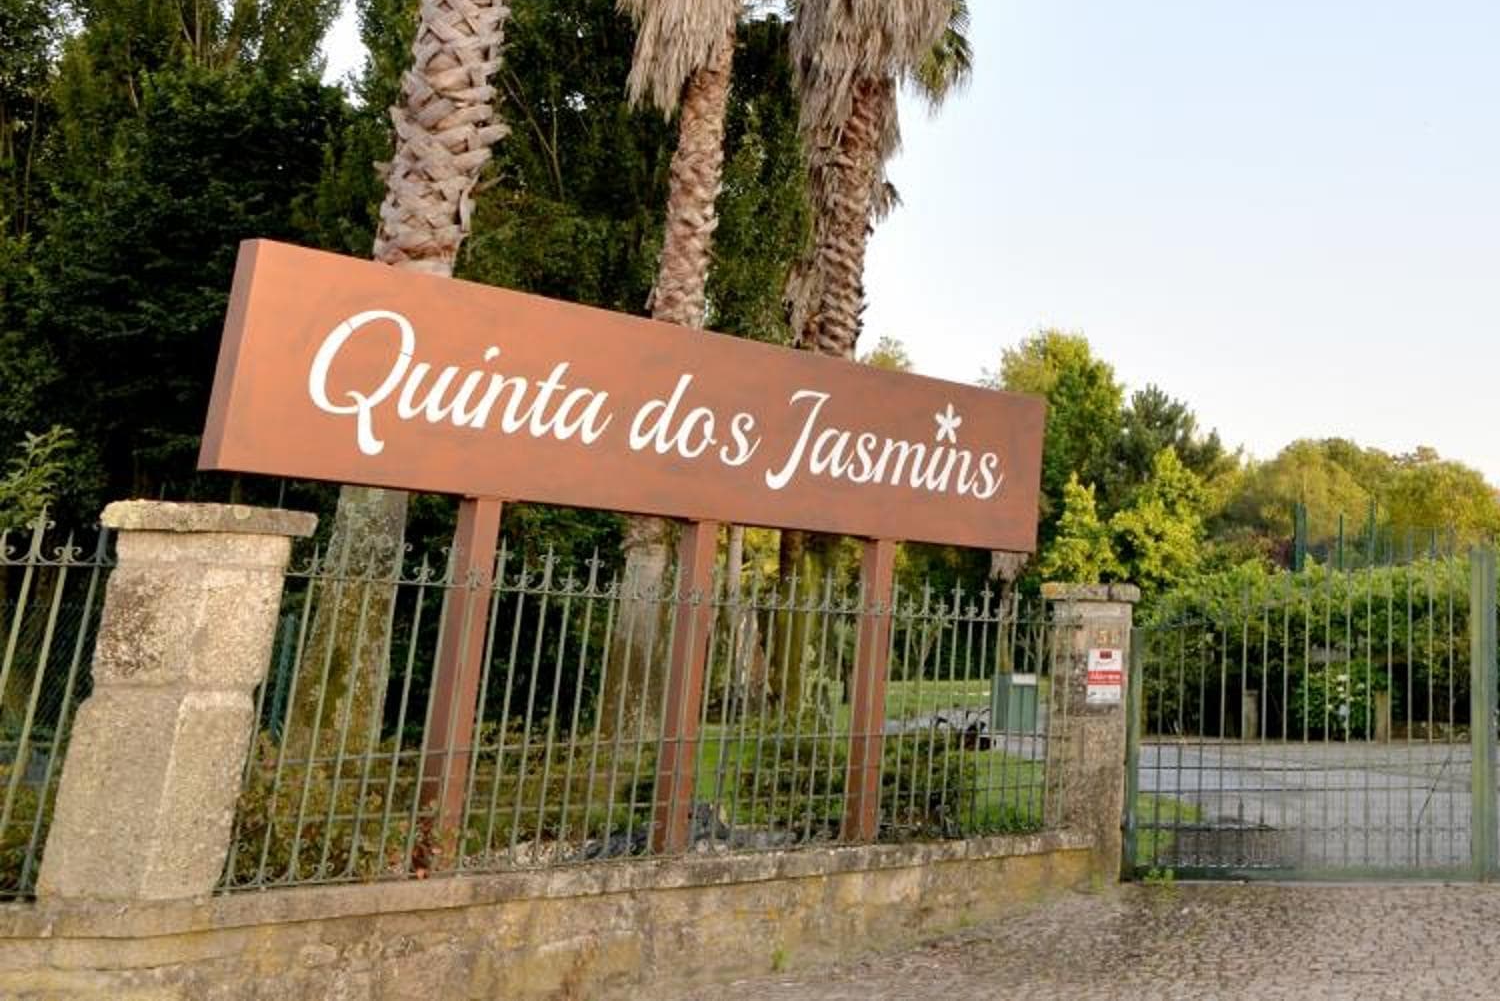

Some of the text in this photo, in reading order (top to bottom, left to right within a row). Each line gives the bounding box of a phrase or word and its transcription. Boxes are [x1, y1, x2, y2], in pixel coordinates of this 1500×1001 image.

[307, 310, 1003, 501] Quinta dos Jasmins
